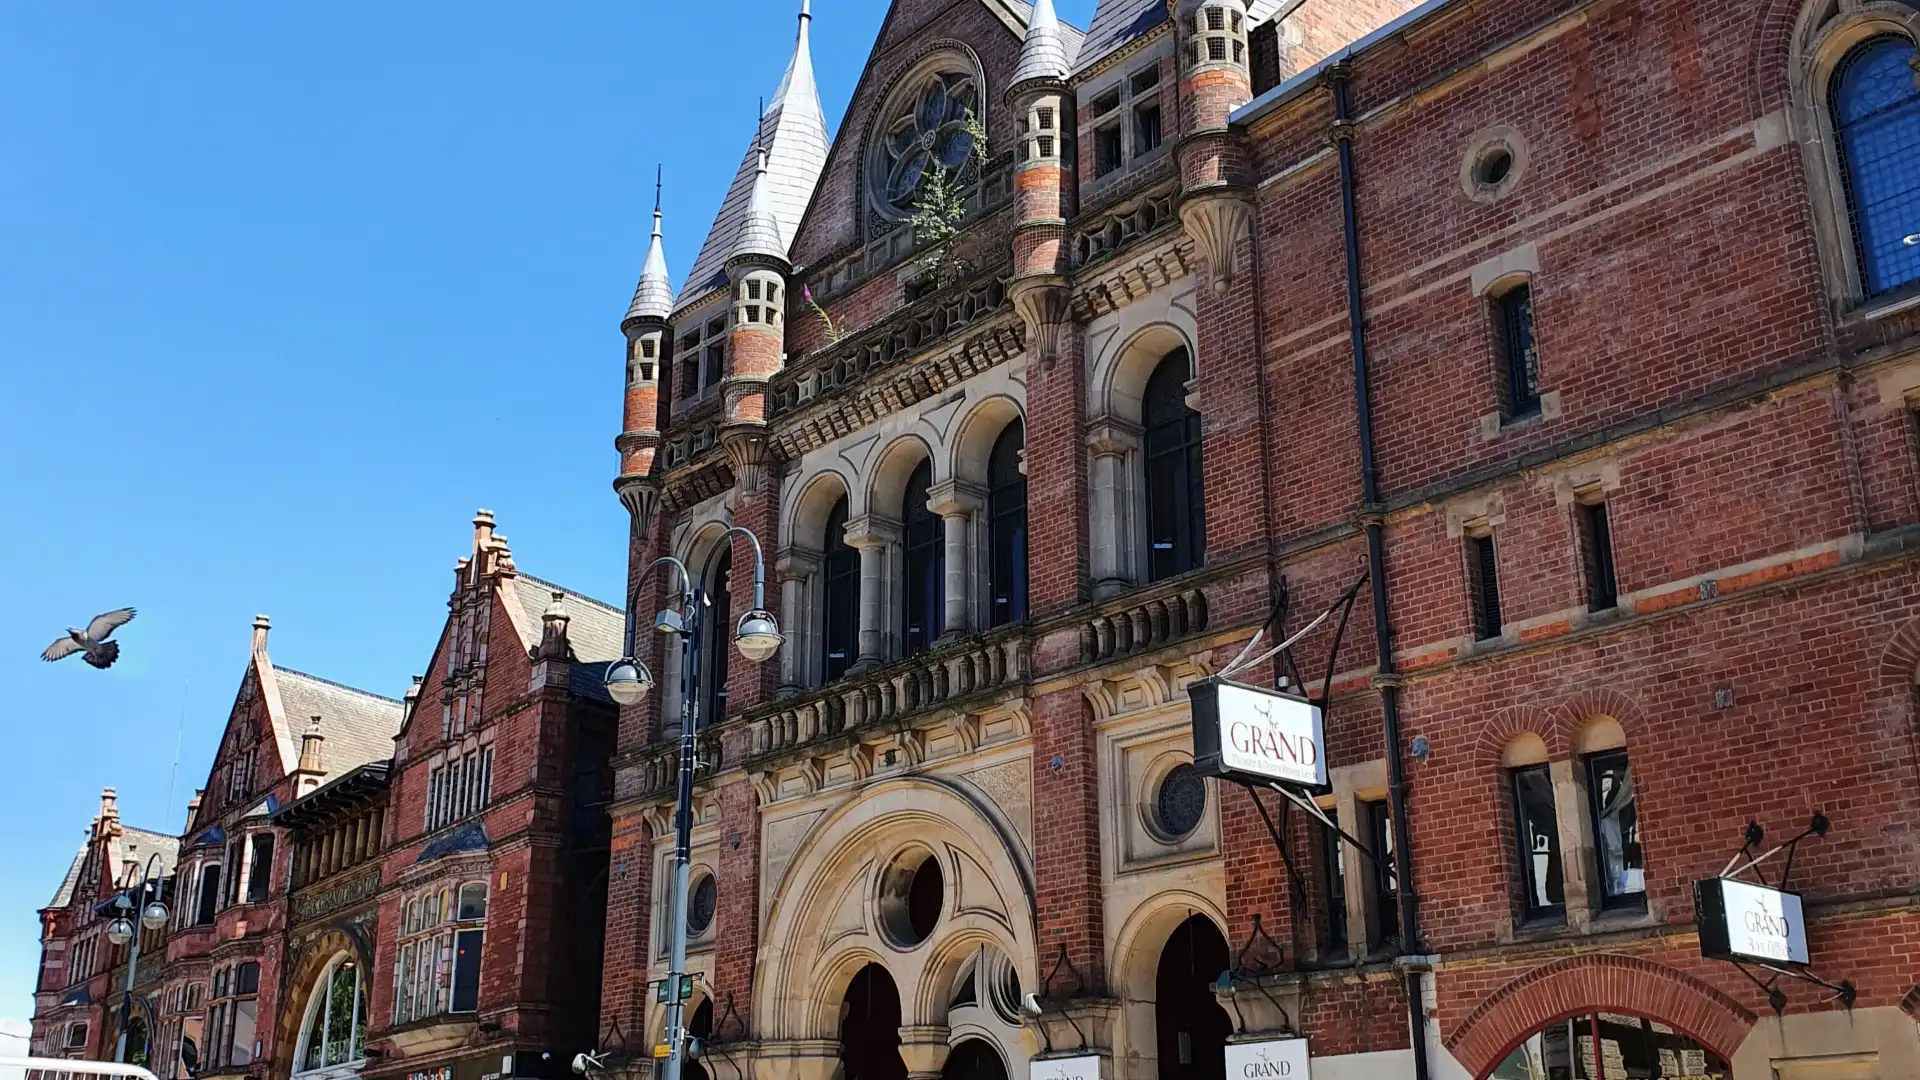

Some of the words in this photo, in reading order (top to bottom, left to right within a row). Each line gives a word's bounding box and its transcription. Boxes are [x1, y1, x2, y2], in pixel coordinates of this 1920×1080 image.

[1230, 721, 1317, 766] GRAND
[1744, 910, 1790, 938] GRAND
[1243, 1060, 1291, 1079] GRAND
